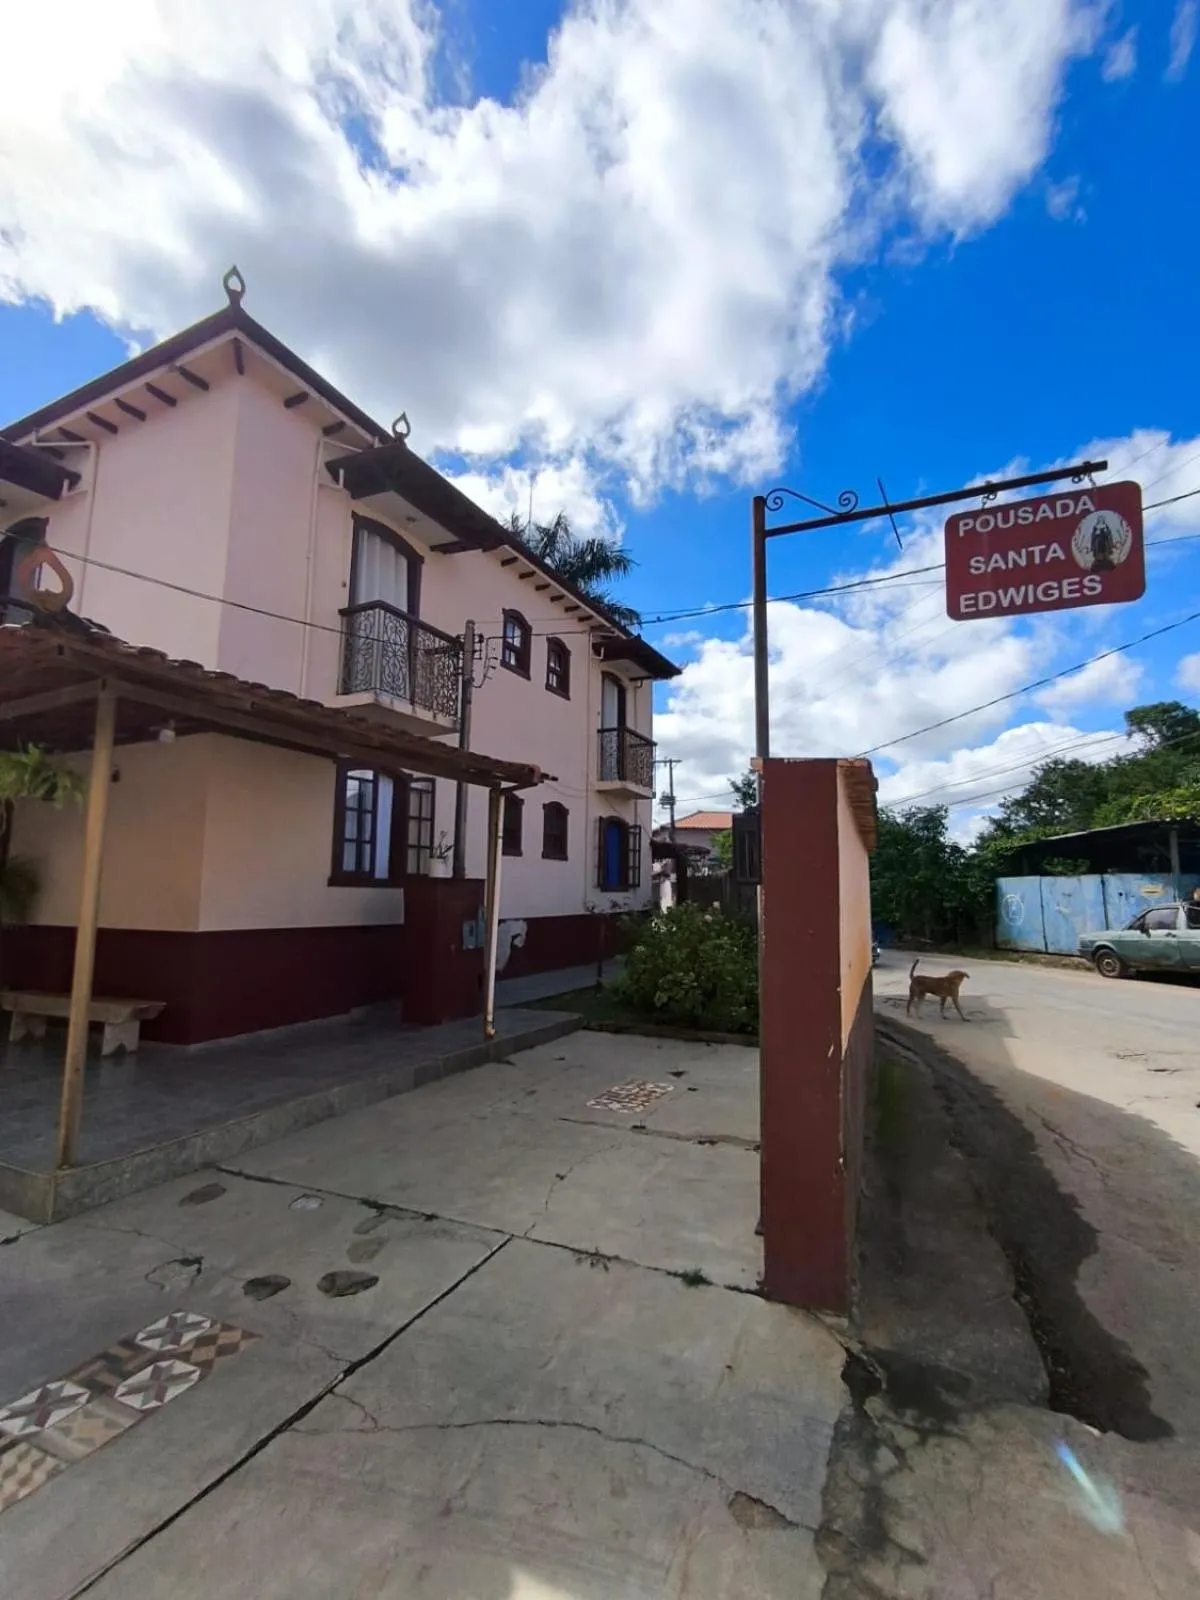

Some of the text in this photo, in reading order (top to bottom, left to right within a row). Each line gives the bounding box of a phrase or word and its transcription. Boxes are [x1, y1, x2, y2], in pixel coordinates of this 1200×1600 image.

[959, 495, 1095, 537] POUSADA
[969, 542, 1065, 575] SANTA
[959, 575, 1102, 613] EDWIGES
